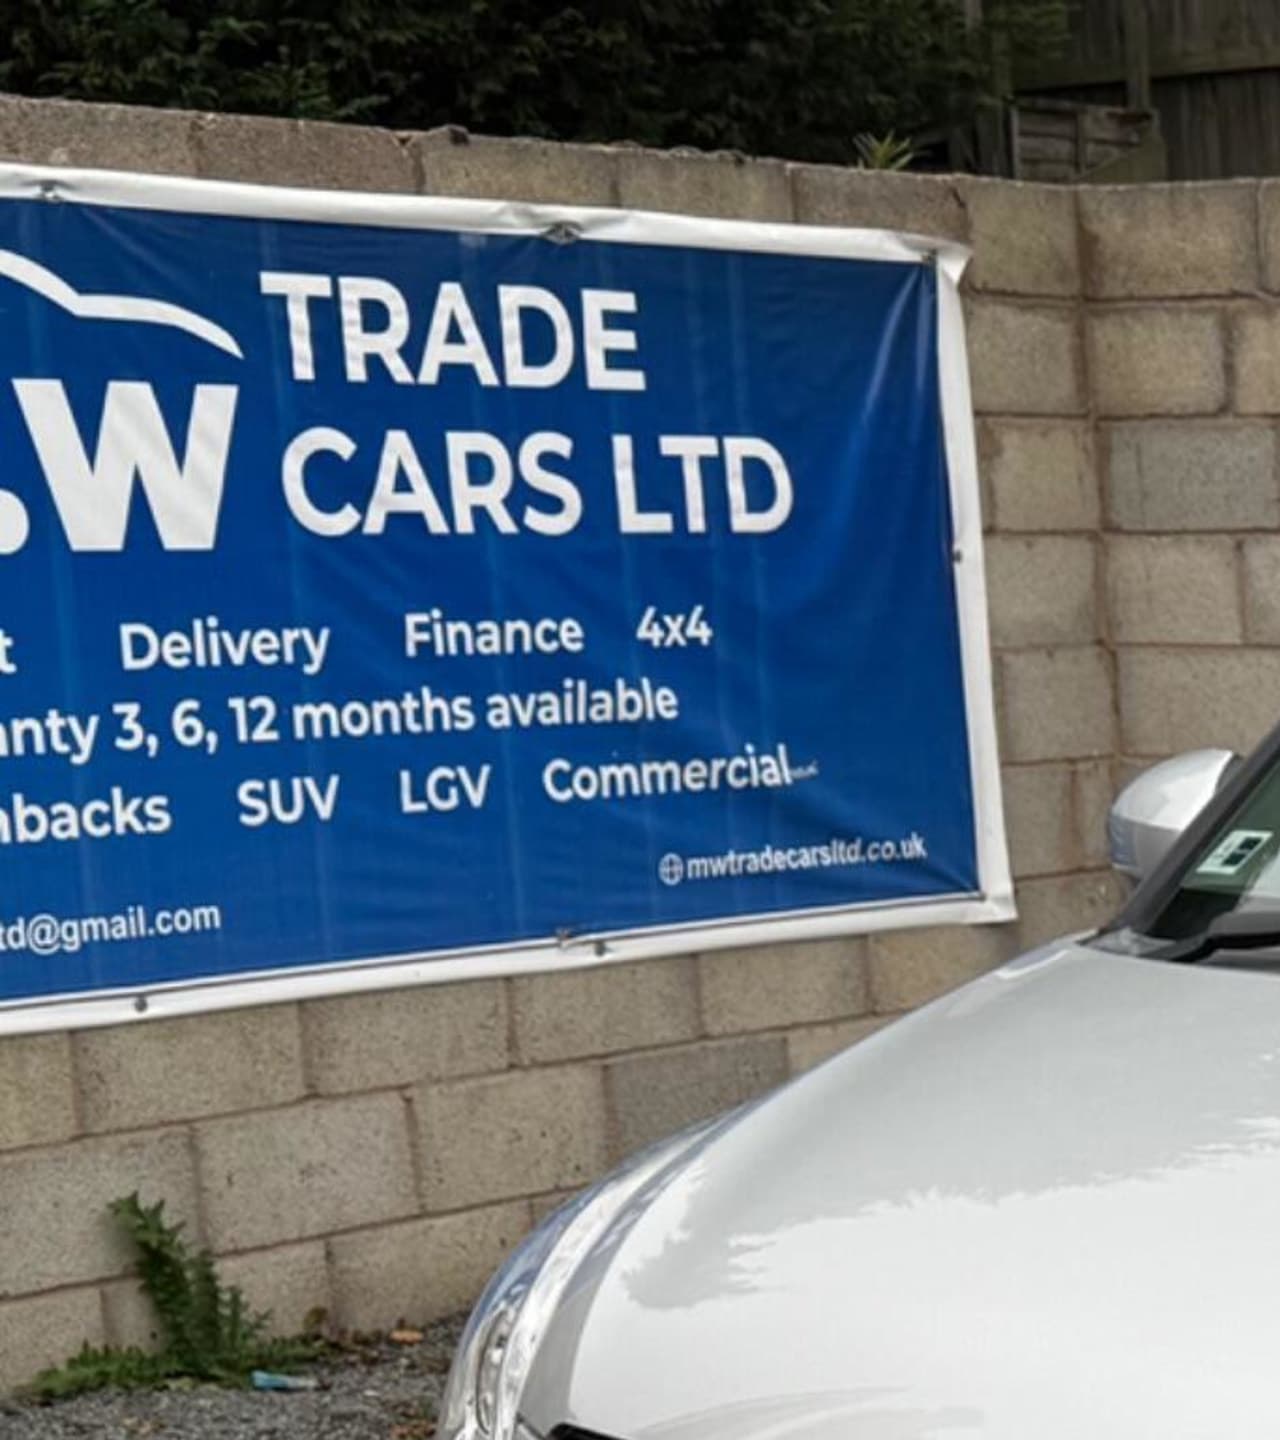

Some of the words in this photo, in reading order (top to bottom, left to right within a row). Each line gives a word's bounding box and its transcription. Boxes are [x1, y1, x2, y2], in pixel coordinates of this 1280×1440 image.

[259, 270, 646, 391] TRADE
[281, 425, 583, 537] CARS
[612, 434, 794, 534] LTD
[119, 615, 330, 676] Delivery
[404, 608, 584, 658] Finance
[636, 605, 714, 649] 4x4
[112, 702, 158, 758] 3,
[172, 699, 218, 755] 6,
[228, 696, 279, 743] 12
[292, 686, 476, 740] months
[486, 677, 679, 729] available
[237, 774, 340, 827] SUV
[400, 764, 491, 814] LGV
[543, 742, 793, 802] Commercial
[687, 832, 928, 879] mwtradecarsltd.co.uk
